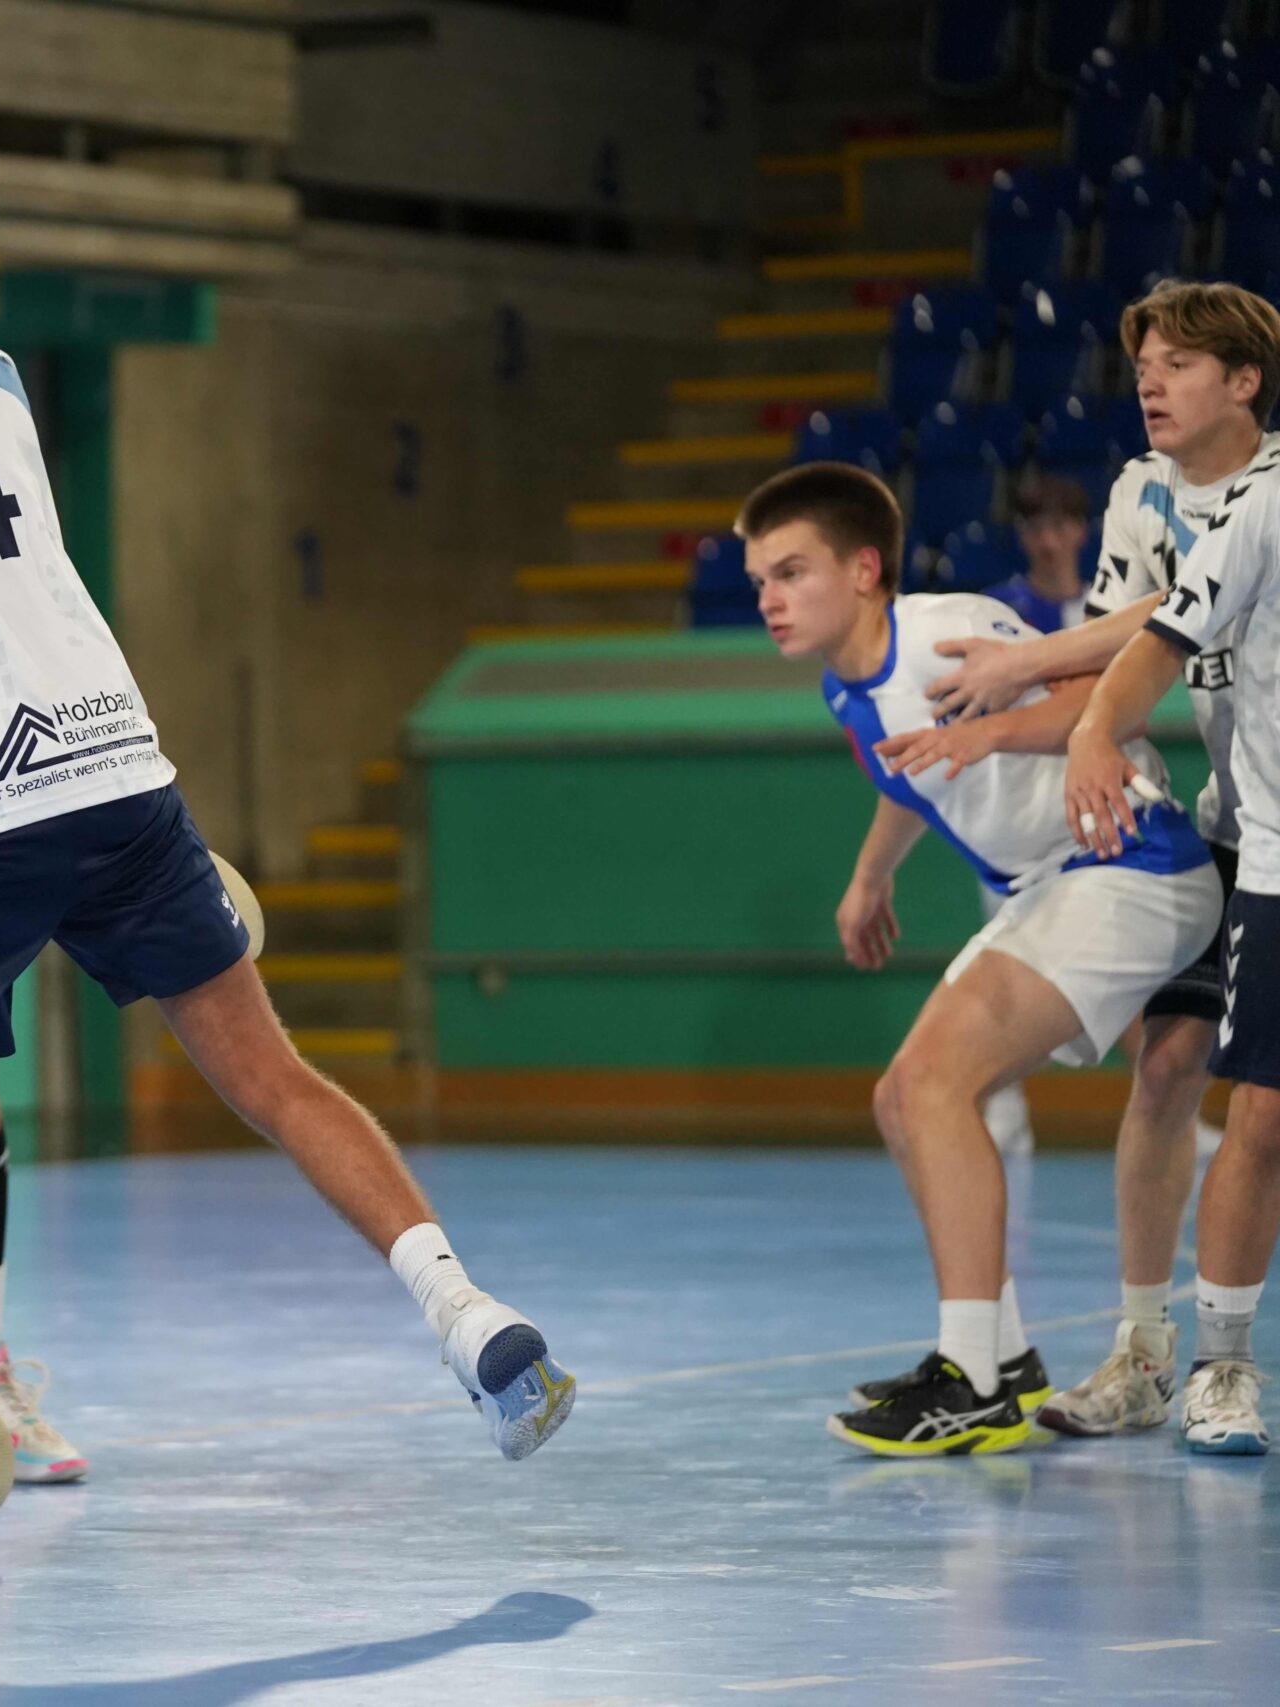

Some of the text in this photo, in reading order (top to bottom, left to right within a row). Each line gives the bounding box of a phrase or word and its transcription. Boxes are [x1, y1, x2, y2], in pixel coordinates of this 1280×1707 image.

[52, 691, 134, 725] Holzbau
[63, 718, 132, 745] Bühlmann
[5, 768, 71, 798] Spezialist
[74, 756, 118, 777] wenn's
[119, 752, 138, 766] um
